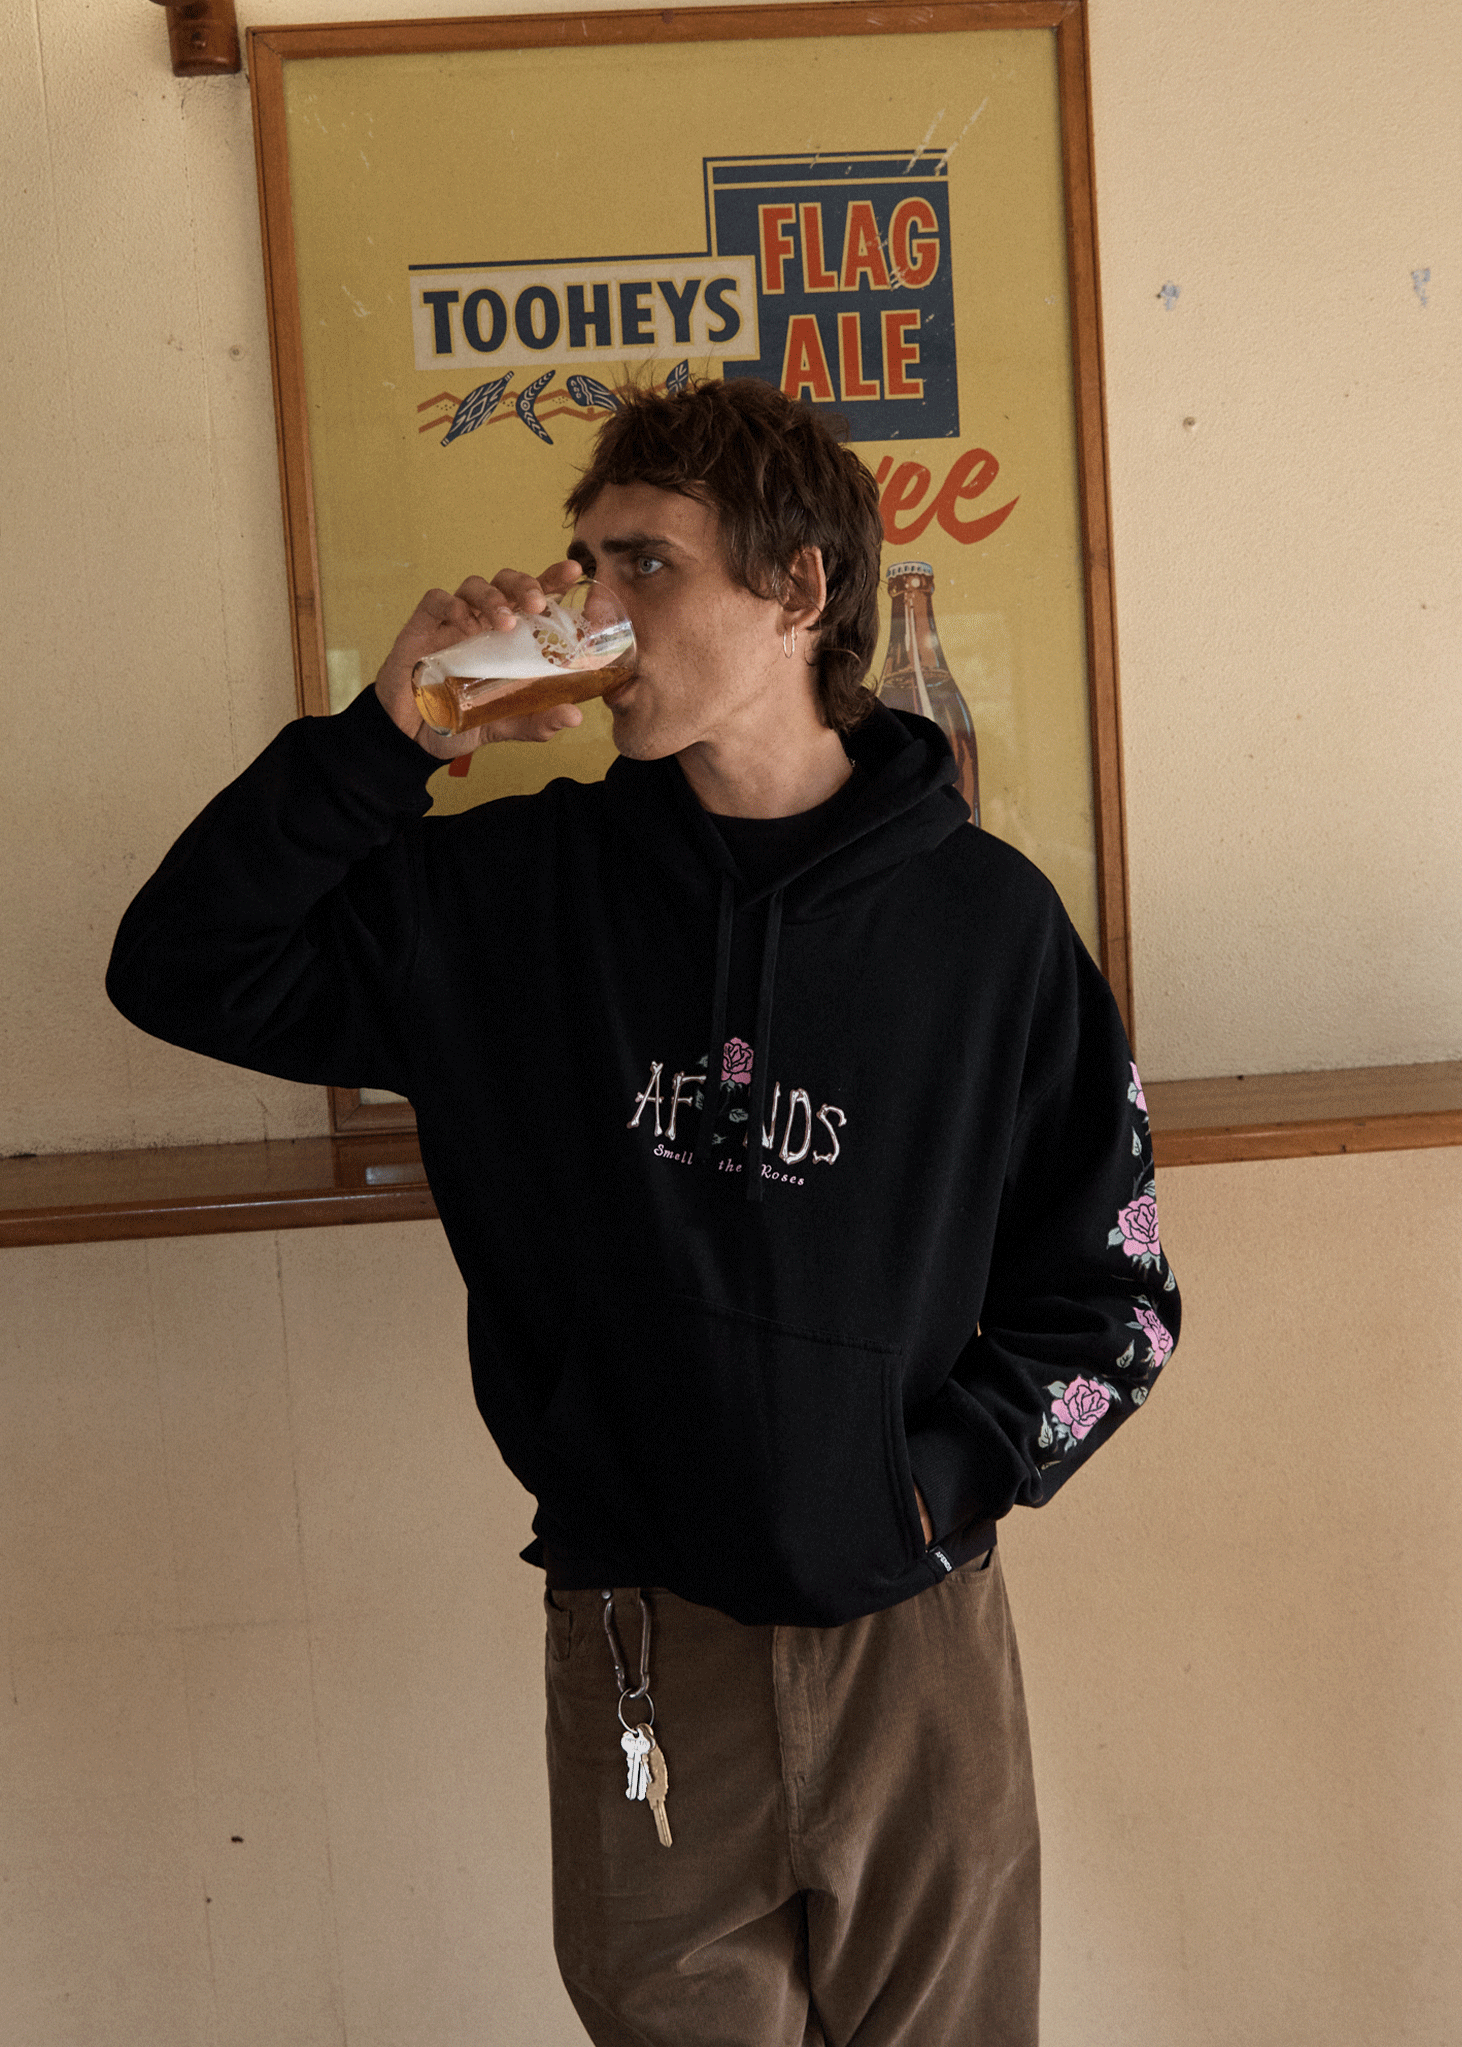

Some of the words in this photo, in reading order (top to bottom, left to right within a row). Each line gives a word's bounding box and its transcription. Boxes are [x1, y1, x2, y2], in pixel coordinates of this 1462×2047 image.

[758, 196, 941, 295] FLAG
[421, 276, 742, 356] TOOHEYS
[779, 308, 926, 403] ALE
[653, 1143, 694, 1165] Smell
[718, 1158, 743, 1173] the
[760, 1163, 806, 1186] Roses
